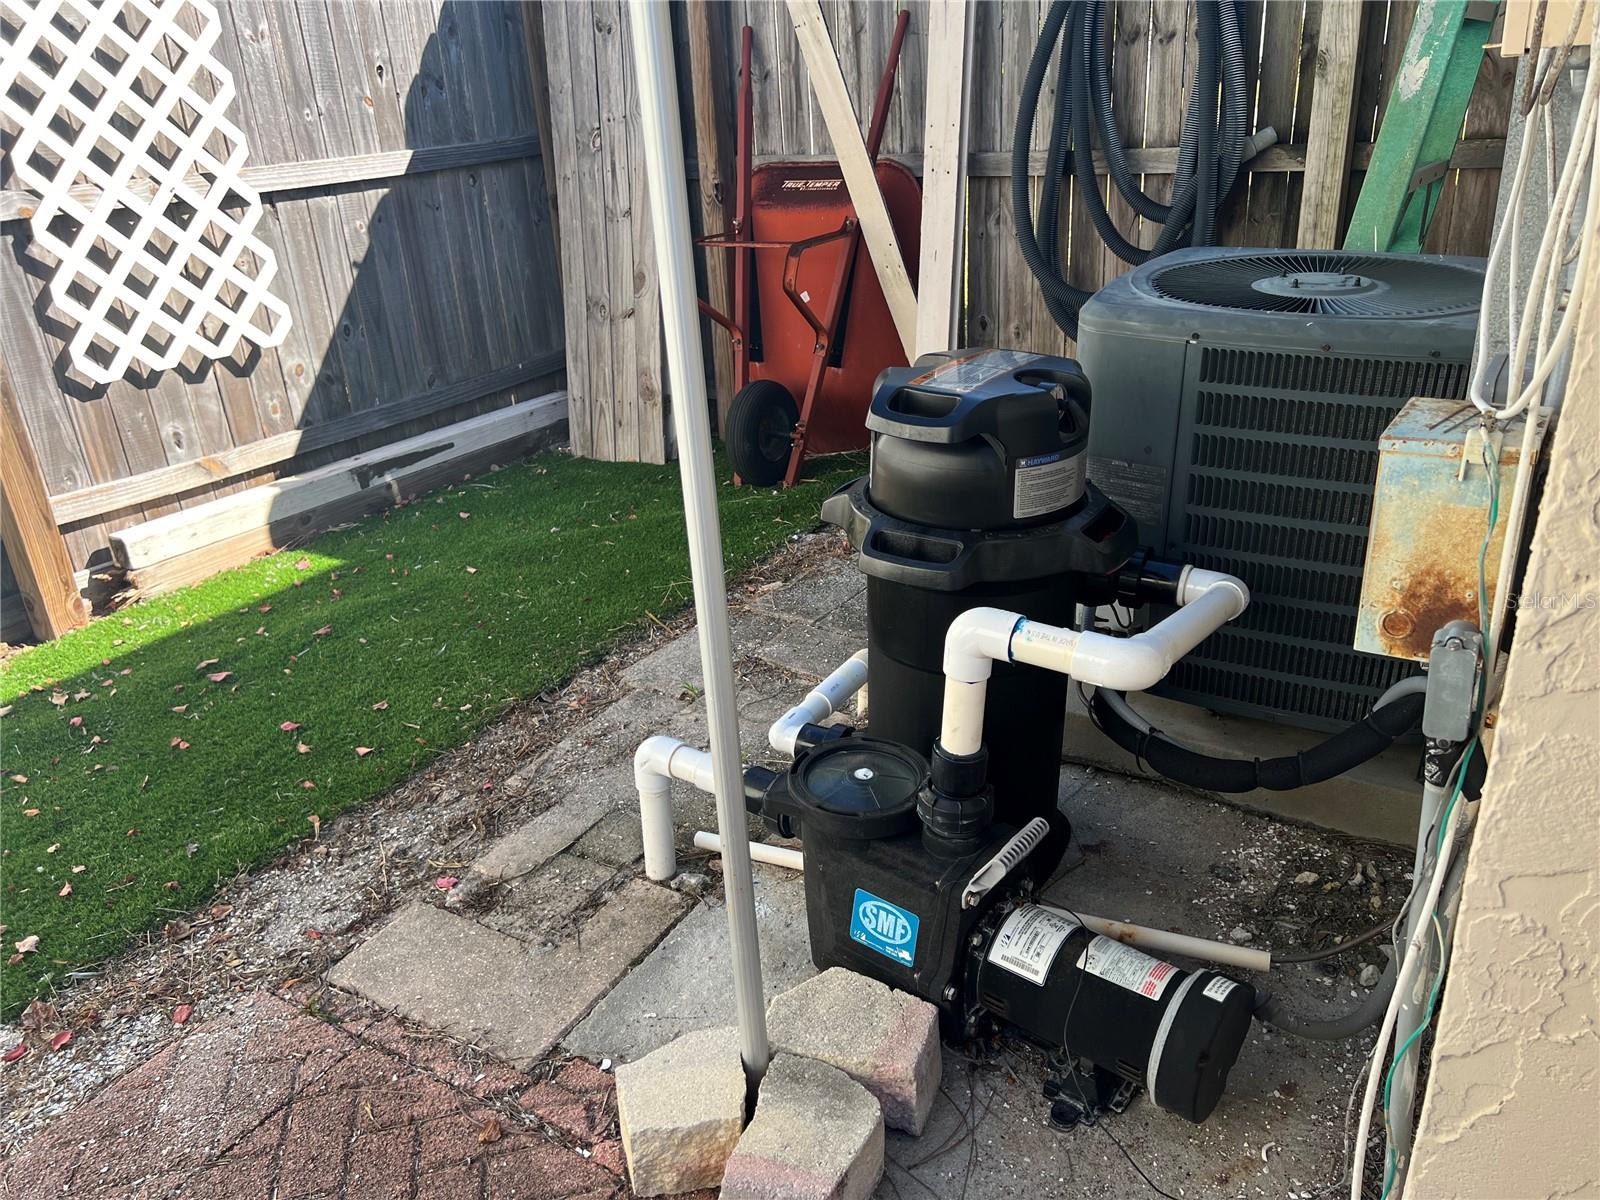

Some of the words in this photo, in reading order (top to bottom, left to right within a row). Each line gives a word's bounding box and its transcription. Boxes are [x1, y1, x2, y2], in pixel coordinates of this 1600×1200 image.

[782, 180, 807, 189] TRUE
[806, 179, 843, 188] TEMPER
[864, 904, 908, 942] SMF
